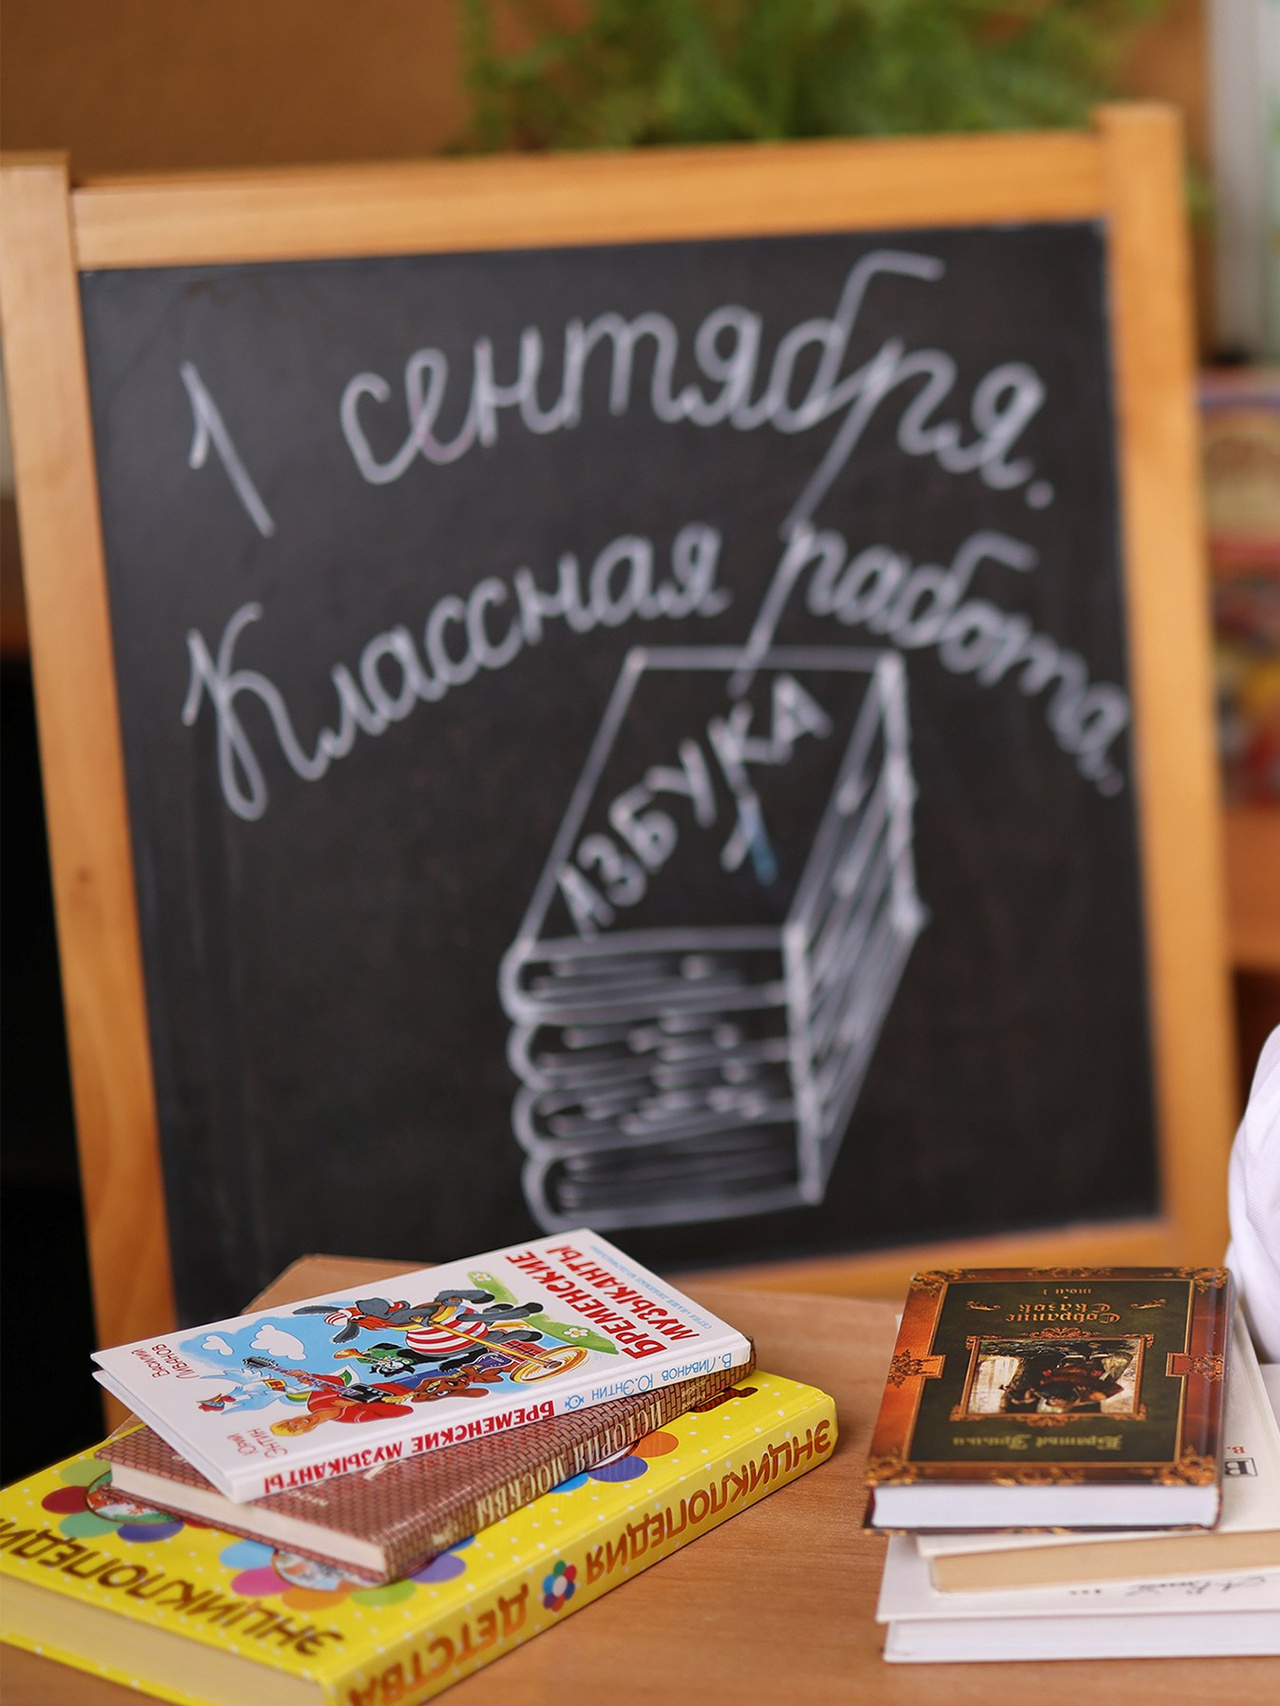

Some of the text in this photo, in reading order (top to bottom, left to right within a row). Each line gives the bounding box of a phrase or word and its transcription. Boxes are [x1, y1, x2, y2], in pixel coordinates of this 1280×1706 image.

[180, 359, 276, 539] 1
[182, 520, 731, 823] Классная
[556, 673, 834, 943] АЗБУКА
[505, 1250, 668, 1360] БРЕМЕНСКИЕ
[545, 1244, 700, 1341] МУЗЫКАНТЫ
[1005, 1312, 1122, 1324] Собрание
[1018, 1302, 1112, 1314] Сказок
[263, 1399, 555, 1495] БРЕМЕНСКИЕ МУЗЫКАНТЫ
[475, 1400, 663, 1529] ИСТОРИЯ МОСКВЫ
[586, 1418, 832, 1586] ЭНЦИКЛОПЕДИЯ
